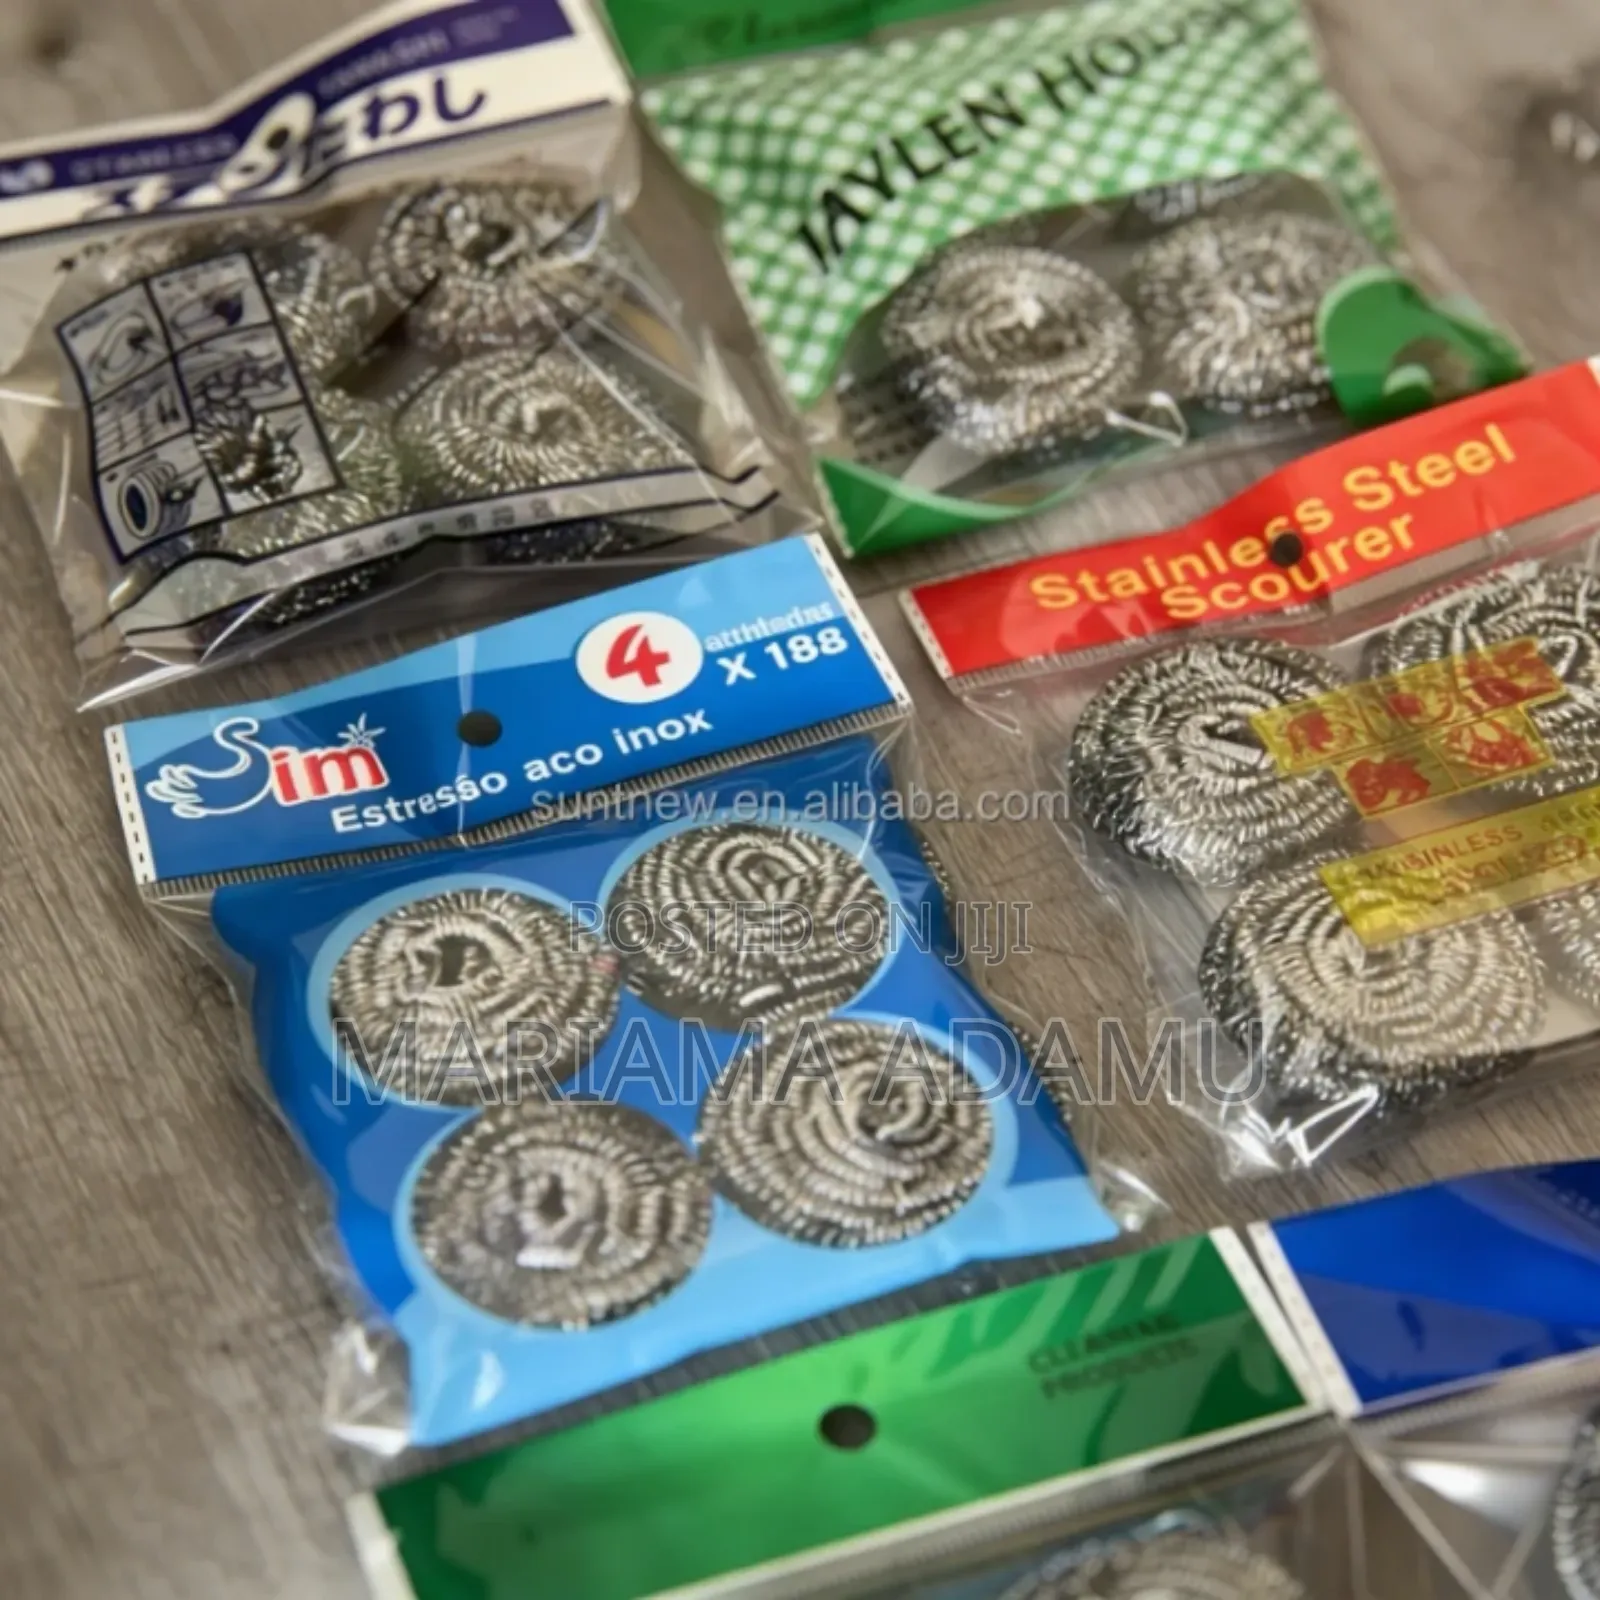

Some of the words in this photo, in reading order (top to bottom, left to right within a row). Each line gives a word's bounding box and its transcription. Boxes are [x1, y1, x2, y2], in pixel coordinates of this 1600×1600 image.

[1342, 422, 1516, 512] Steel
[1160, 513, 1414, 619] Scourer
[605, 622, 671, 688] 4
[763, 626, 849, 671] 188
[522, 743, 604, 783] aco
[611, 707, 714, 756] inox
